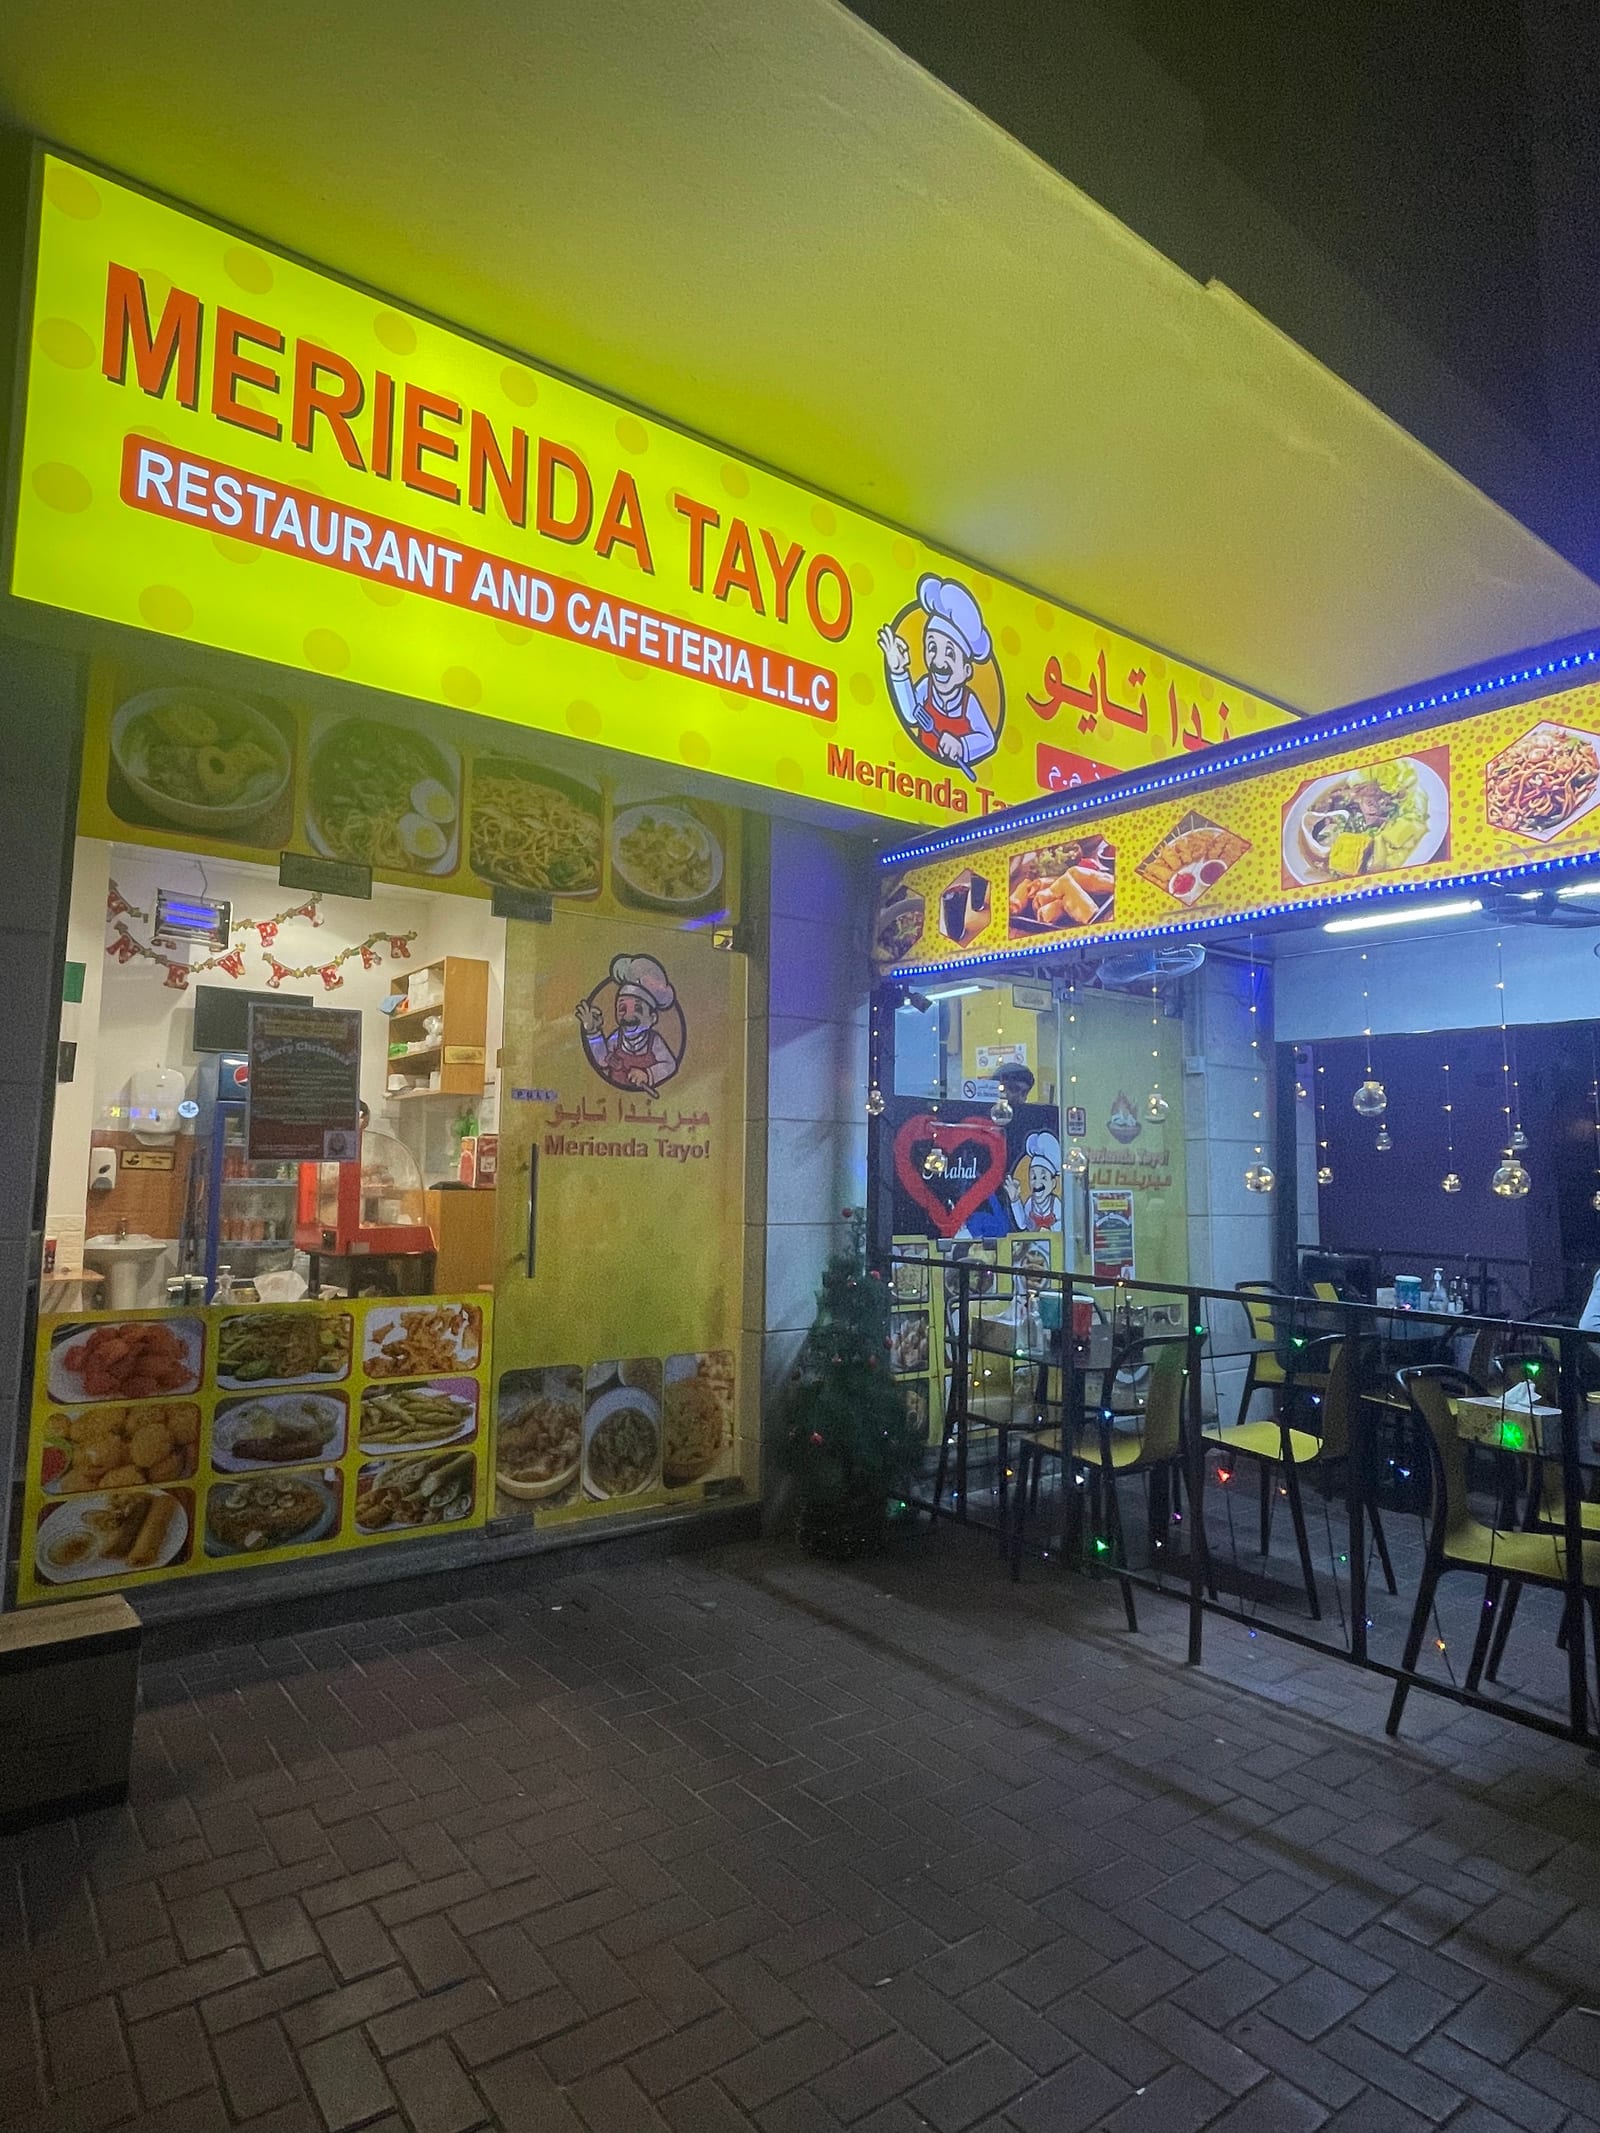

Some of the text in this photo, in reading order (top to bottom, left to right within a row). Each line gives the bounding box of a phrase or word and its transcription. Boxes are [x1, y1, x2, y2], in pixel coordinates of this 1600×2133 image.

[102, 261, 854, 643] MERIENDA TAYO
[137, 447, 830, 712] RESTAURANT AND CAFETERIA L.L.C
[1025, 649, 1148, 734] تايو
[827, 743, 968, 813] Merienda
[544, 1135, 710, 1162] Merienda Tayo!
